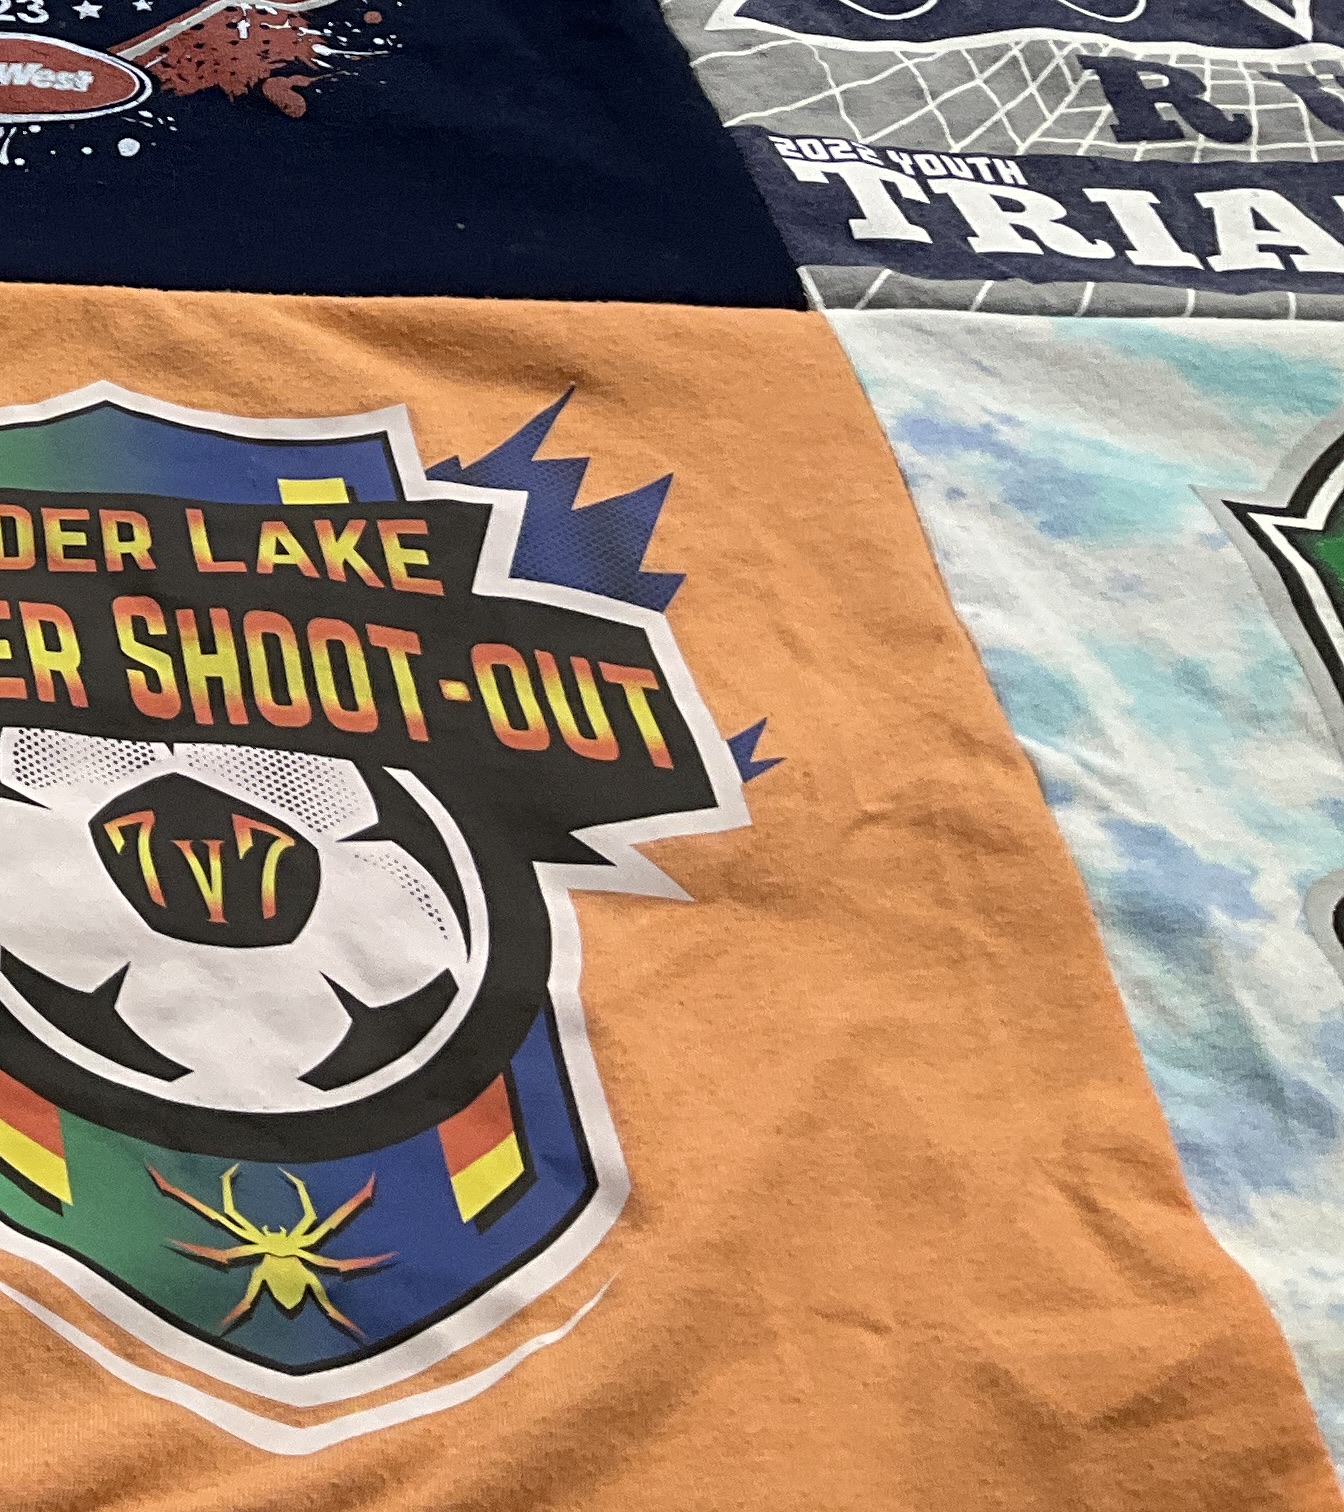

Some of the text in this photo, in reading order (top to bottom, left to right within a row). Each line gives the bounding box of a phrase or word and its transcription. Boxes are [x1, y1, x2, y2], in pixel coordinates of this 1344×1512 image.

[768, 134, 1029, 187] 2022 YOUTH
[790, 160, 1344, 276] TRIA
[190, 508, 447, 596] LAKE
[116, 594, 678, 774] SHOOT-OUT
[105, 807, 300, 928] 7v7
